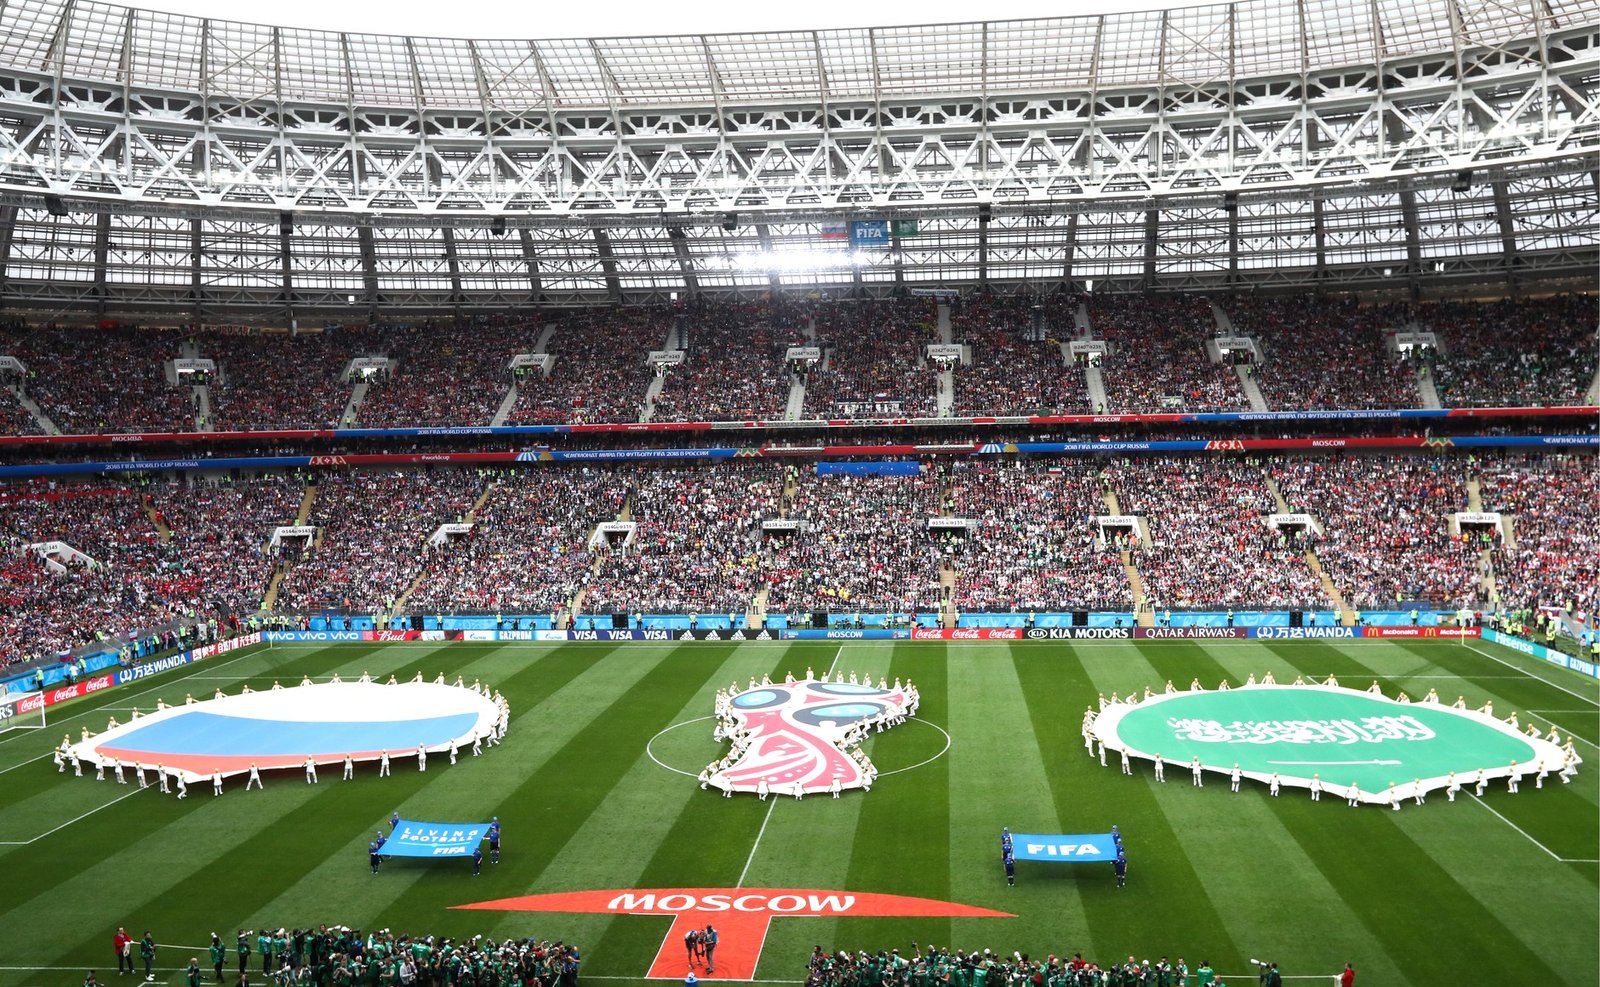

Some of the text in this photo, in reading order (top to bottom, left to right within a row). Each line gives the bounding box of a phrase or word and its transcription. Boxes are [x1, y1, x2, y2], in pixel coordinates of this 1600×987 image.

[856, 228, 882, 239] FIFA
[298, 631, 327, 640] vivo
[330, 631, 359, 640] vivo
[376, 630, 407, 641] Bud
[499, 630, 532, 640] GAZPROM
[572, 630, 598, 640] VISA
[607, 630, 633, 640] VISA
[642, 630, 668, 640] VISA
[915, 629, 943, 639] Coca-Cola
[952, 629, 980, 639] Coca-Cola
[988, 629, 1016, 639] Coca-Cola
[1049, 628, 1129, 638] KIA MOTORS
[1146, 628, 1236, 639] QATAR AIRWAYS
[1494, 633, 1534, 655] Hisense
[86, 676, 110, 693] Coca-Cola
[54, 685, 79, 702] Coca-Cola
[404, 827, 479, 837] LIVING
[400, 833, 474, 843] FOOTBALL
[432, 846, 466, 855] FIFA
[1027, 843, 1102, 856] FIFA
[607, 893, 856, 912] MOSCOW
